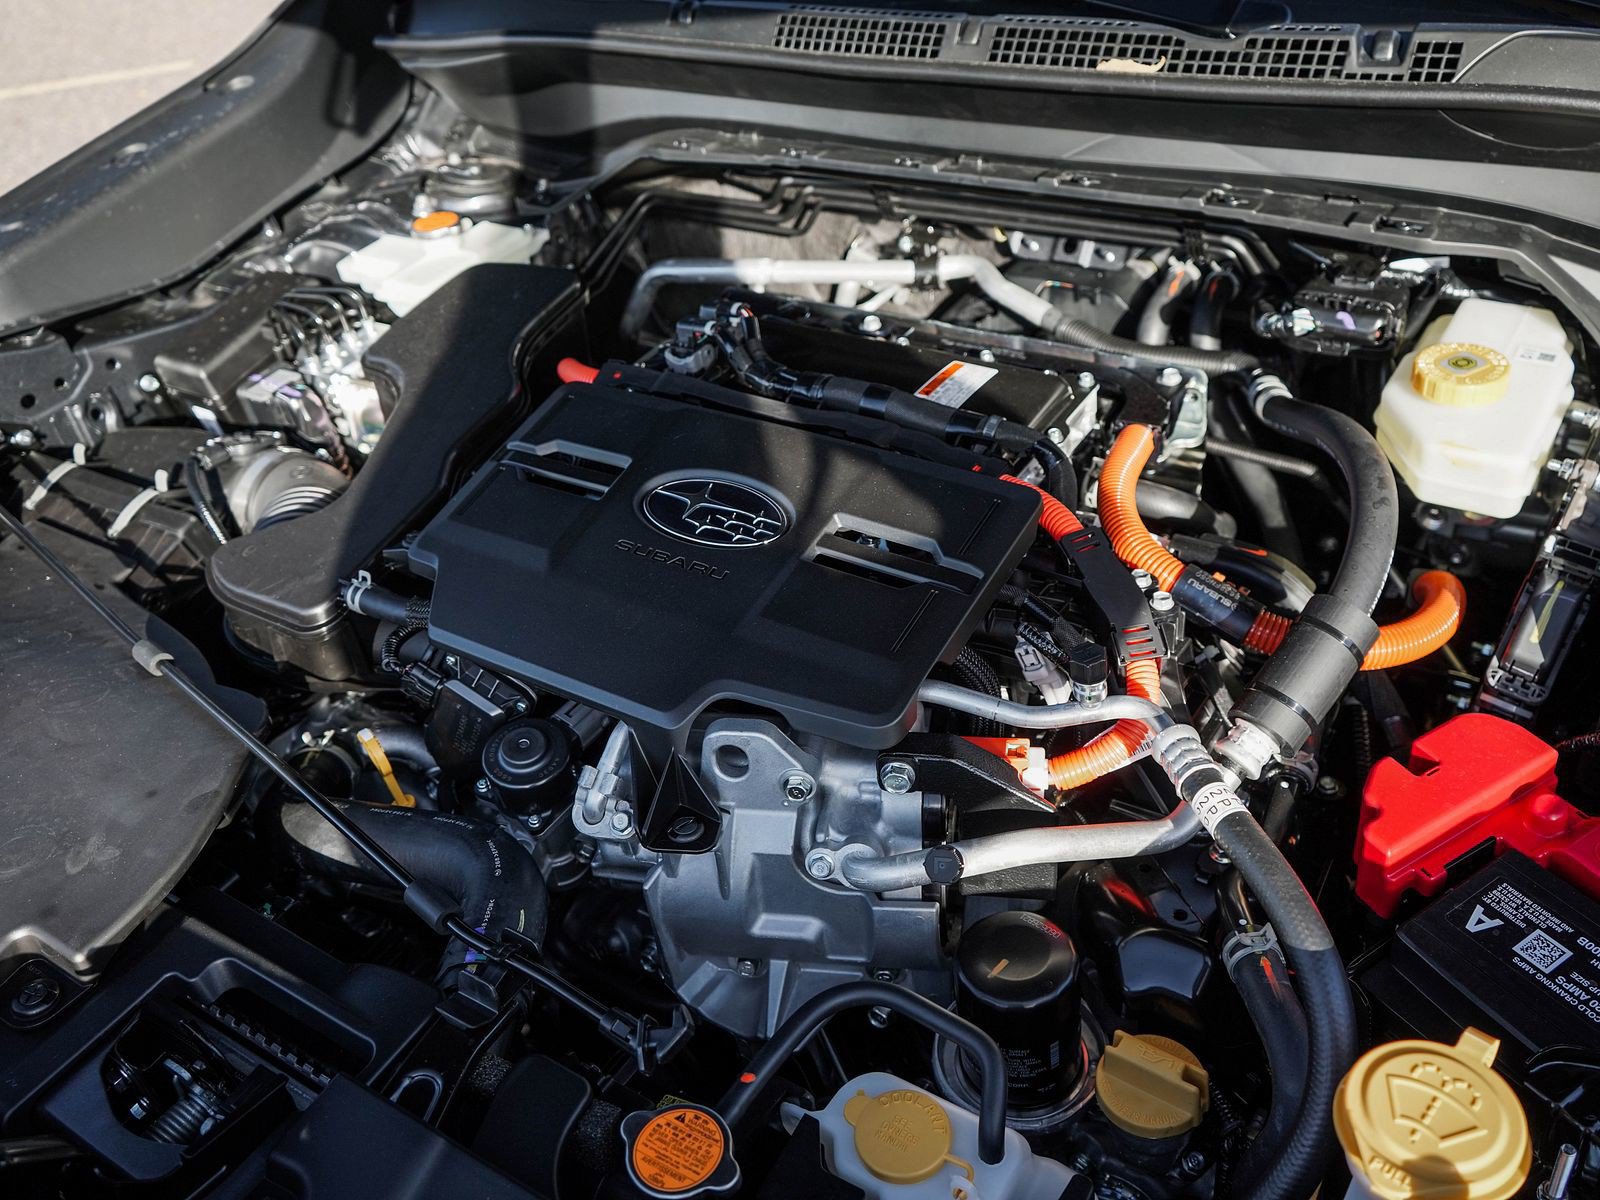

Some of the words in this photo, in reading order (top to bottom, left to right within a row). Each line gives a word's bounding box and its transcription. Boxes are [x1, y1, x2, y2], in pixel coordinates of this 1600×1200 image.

[614, 538, 731, 581] SUBARU
[1187, 578, 1231, 608] SUBARU
[1501, 883, 1533, 905] MATERIALS
[1506, 893, 1522, 904] WITH
[1465, 903, 1505, 933] A
[1532, 903, 1562, 924] IMPORTED
[1545, 919, 1563, 932] MADE
[1560, 923, 1574, 932] AND
[1577, 936, 1600, 957] 00B
[1512, 957, 1536, 974] AMPS
[1535, 973, 1578, 1005] CRANKING
[1555, 976, 1591, 1000] AMPS
[1570, 971, 1590, 986] SIZE
[1578, 1004, 1600, 1022] COLD
[879, 1091, 947, 1136] COOLANT
